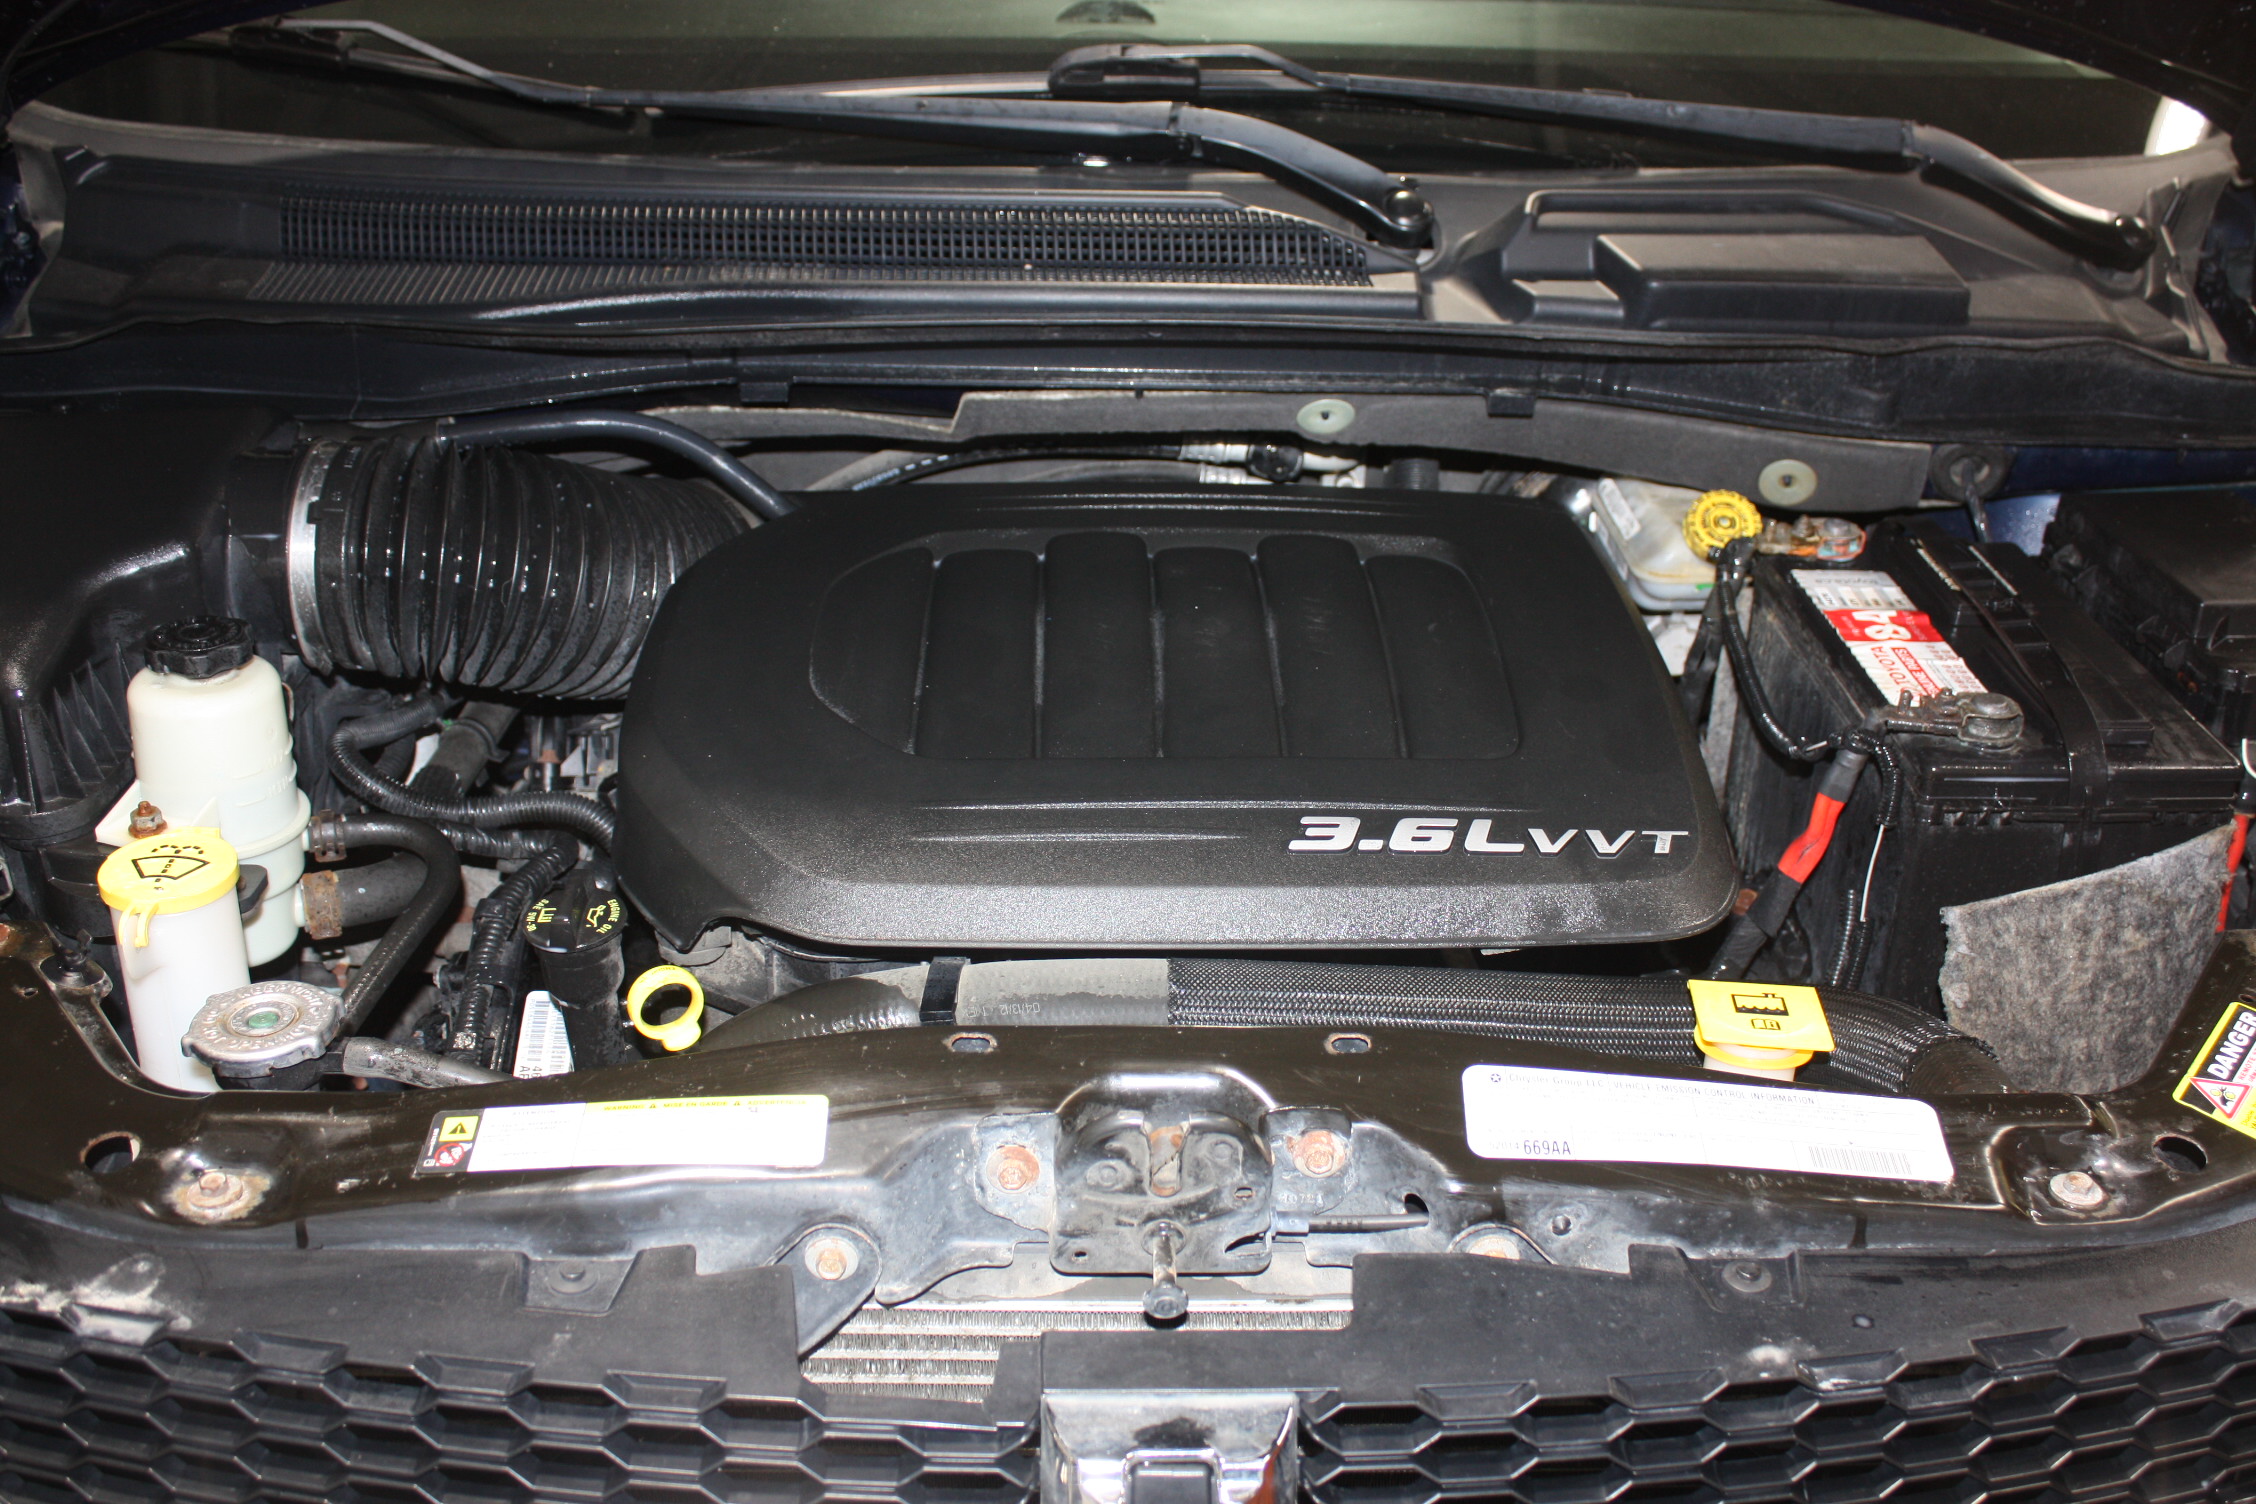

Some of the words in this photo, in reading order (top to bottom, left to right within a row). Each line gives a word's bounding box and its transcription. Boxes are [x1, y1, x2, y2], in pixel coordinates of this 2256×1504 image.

[1852, 610, 1911, 641] 84
[1871, 646, 1910, 686] TOYOTA
[1288, 816, 1525, 854] 3.6L
[1527, 828, 1689, 857] VVT
[606, 898, 621, 923] ENGINE
[595, 923, 612, 934] OIL
[2207, 1010, 2256, 1080] DANGER
[1508, 1072, 1549, 1085] Chrysler
[1552, 1076, 1583, 1088] Group
[1586, 1077, 1605, 1088] LLC
[1613, 1080, 1651, 1091] VEHICLE
[1655, 1083, 1701, 1095] EMISSION
[1704, 1088, 1746, 1100] CONTROL
[1750, 1090, 1816, 1105] INFORMATION
[603, 1103, 646, 1111] WARNING
[1523, 1139, 1572, 1156] 669AA
